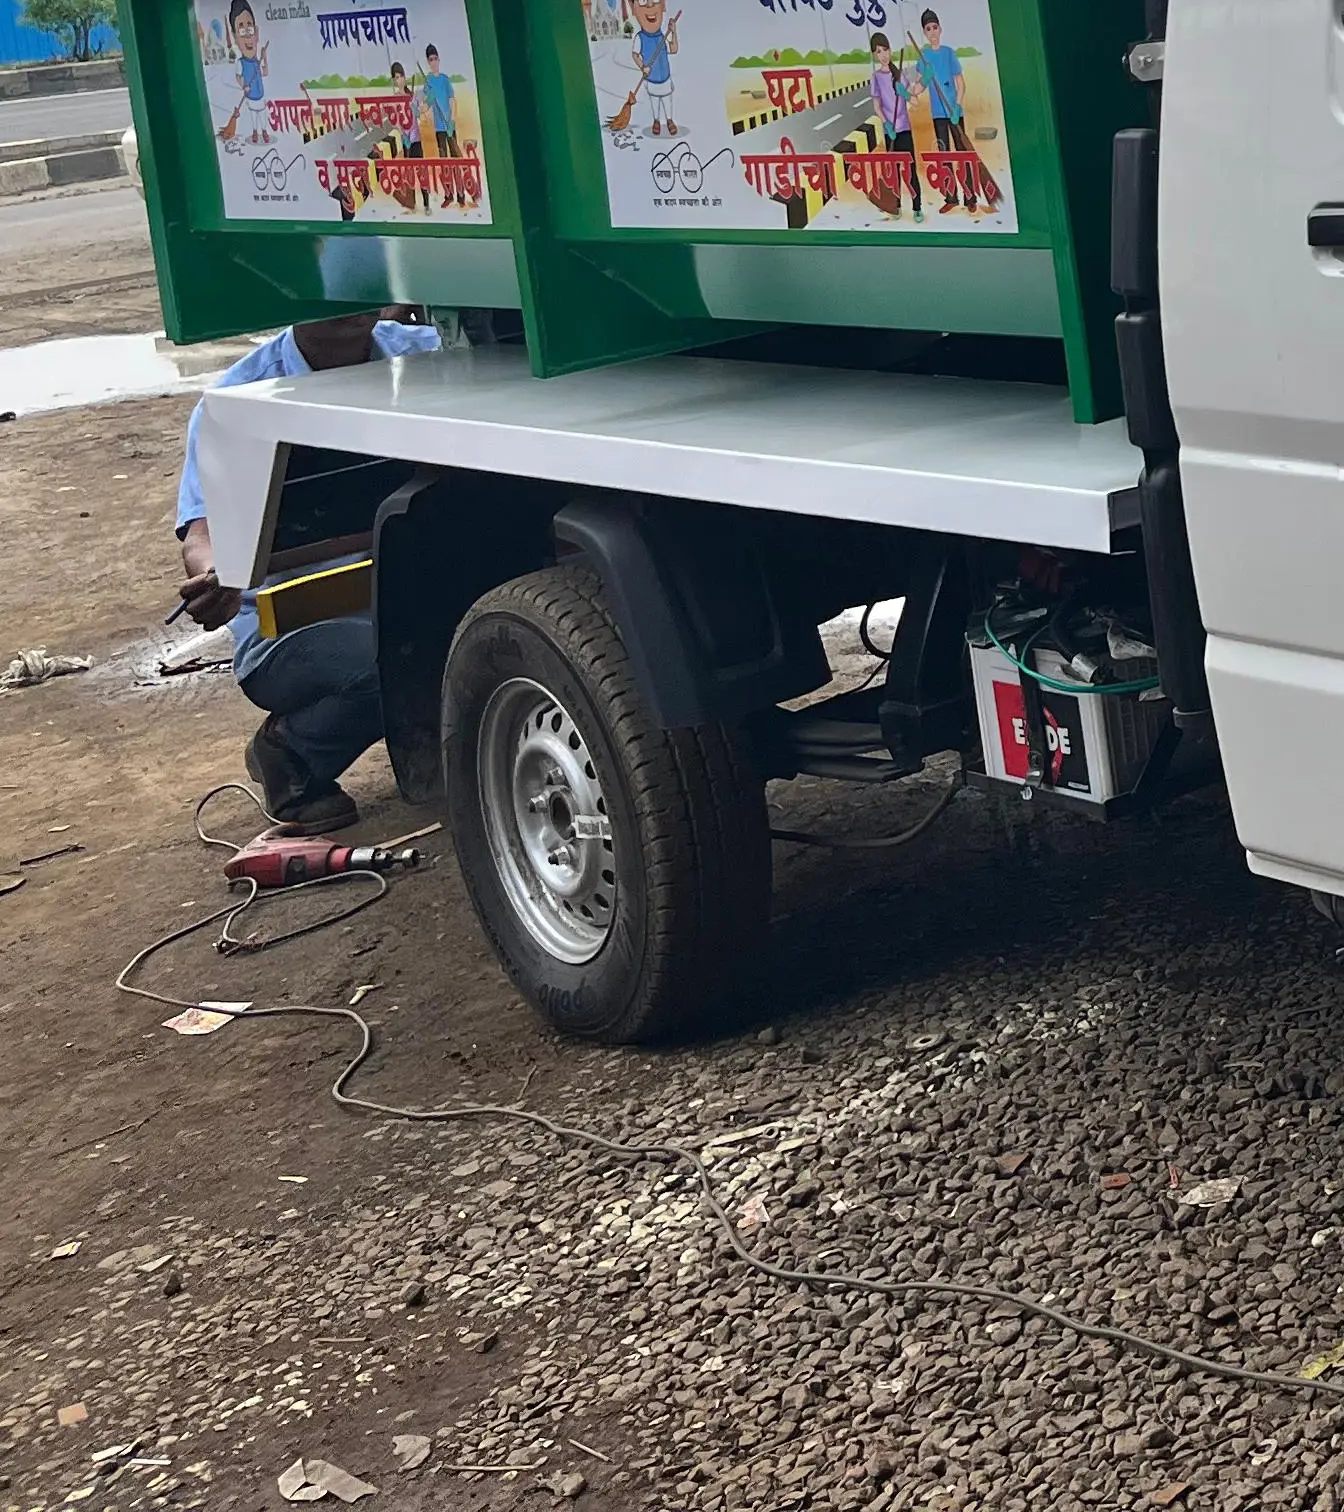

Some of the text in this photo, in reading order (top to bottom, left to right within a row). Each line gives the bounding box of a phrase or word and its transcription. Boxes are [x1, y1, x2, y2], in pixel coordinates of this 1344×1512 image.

[265, 0, 311, 21] clean india
[761, 49, 816, 113] घंटा
[314, 160, 331, 191] व
[740, 137, 838, 199] गाडीचा
[844, 152, 917, 199] वापर
[1012, 718, 1072, 756] EDE
